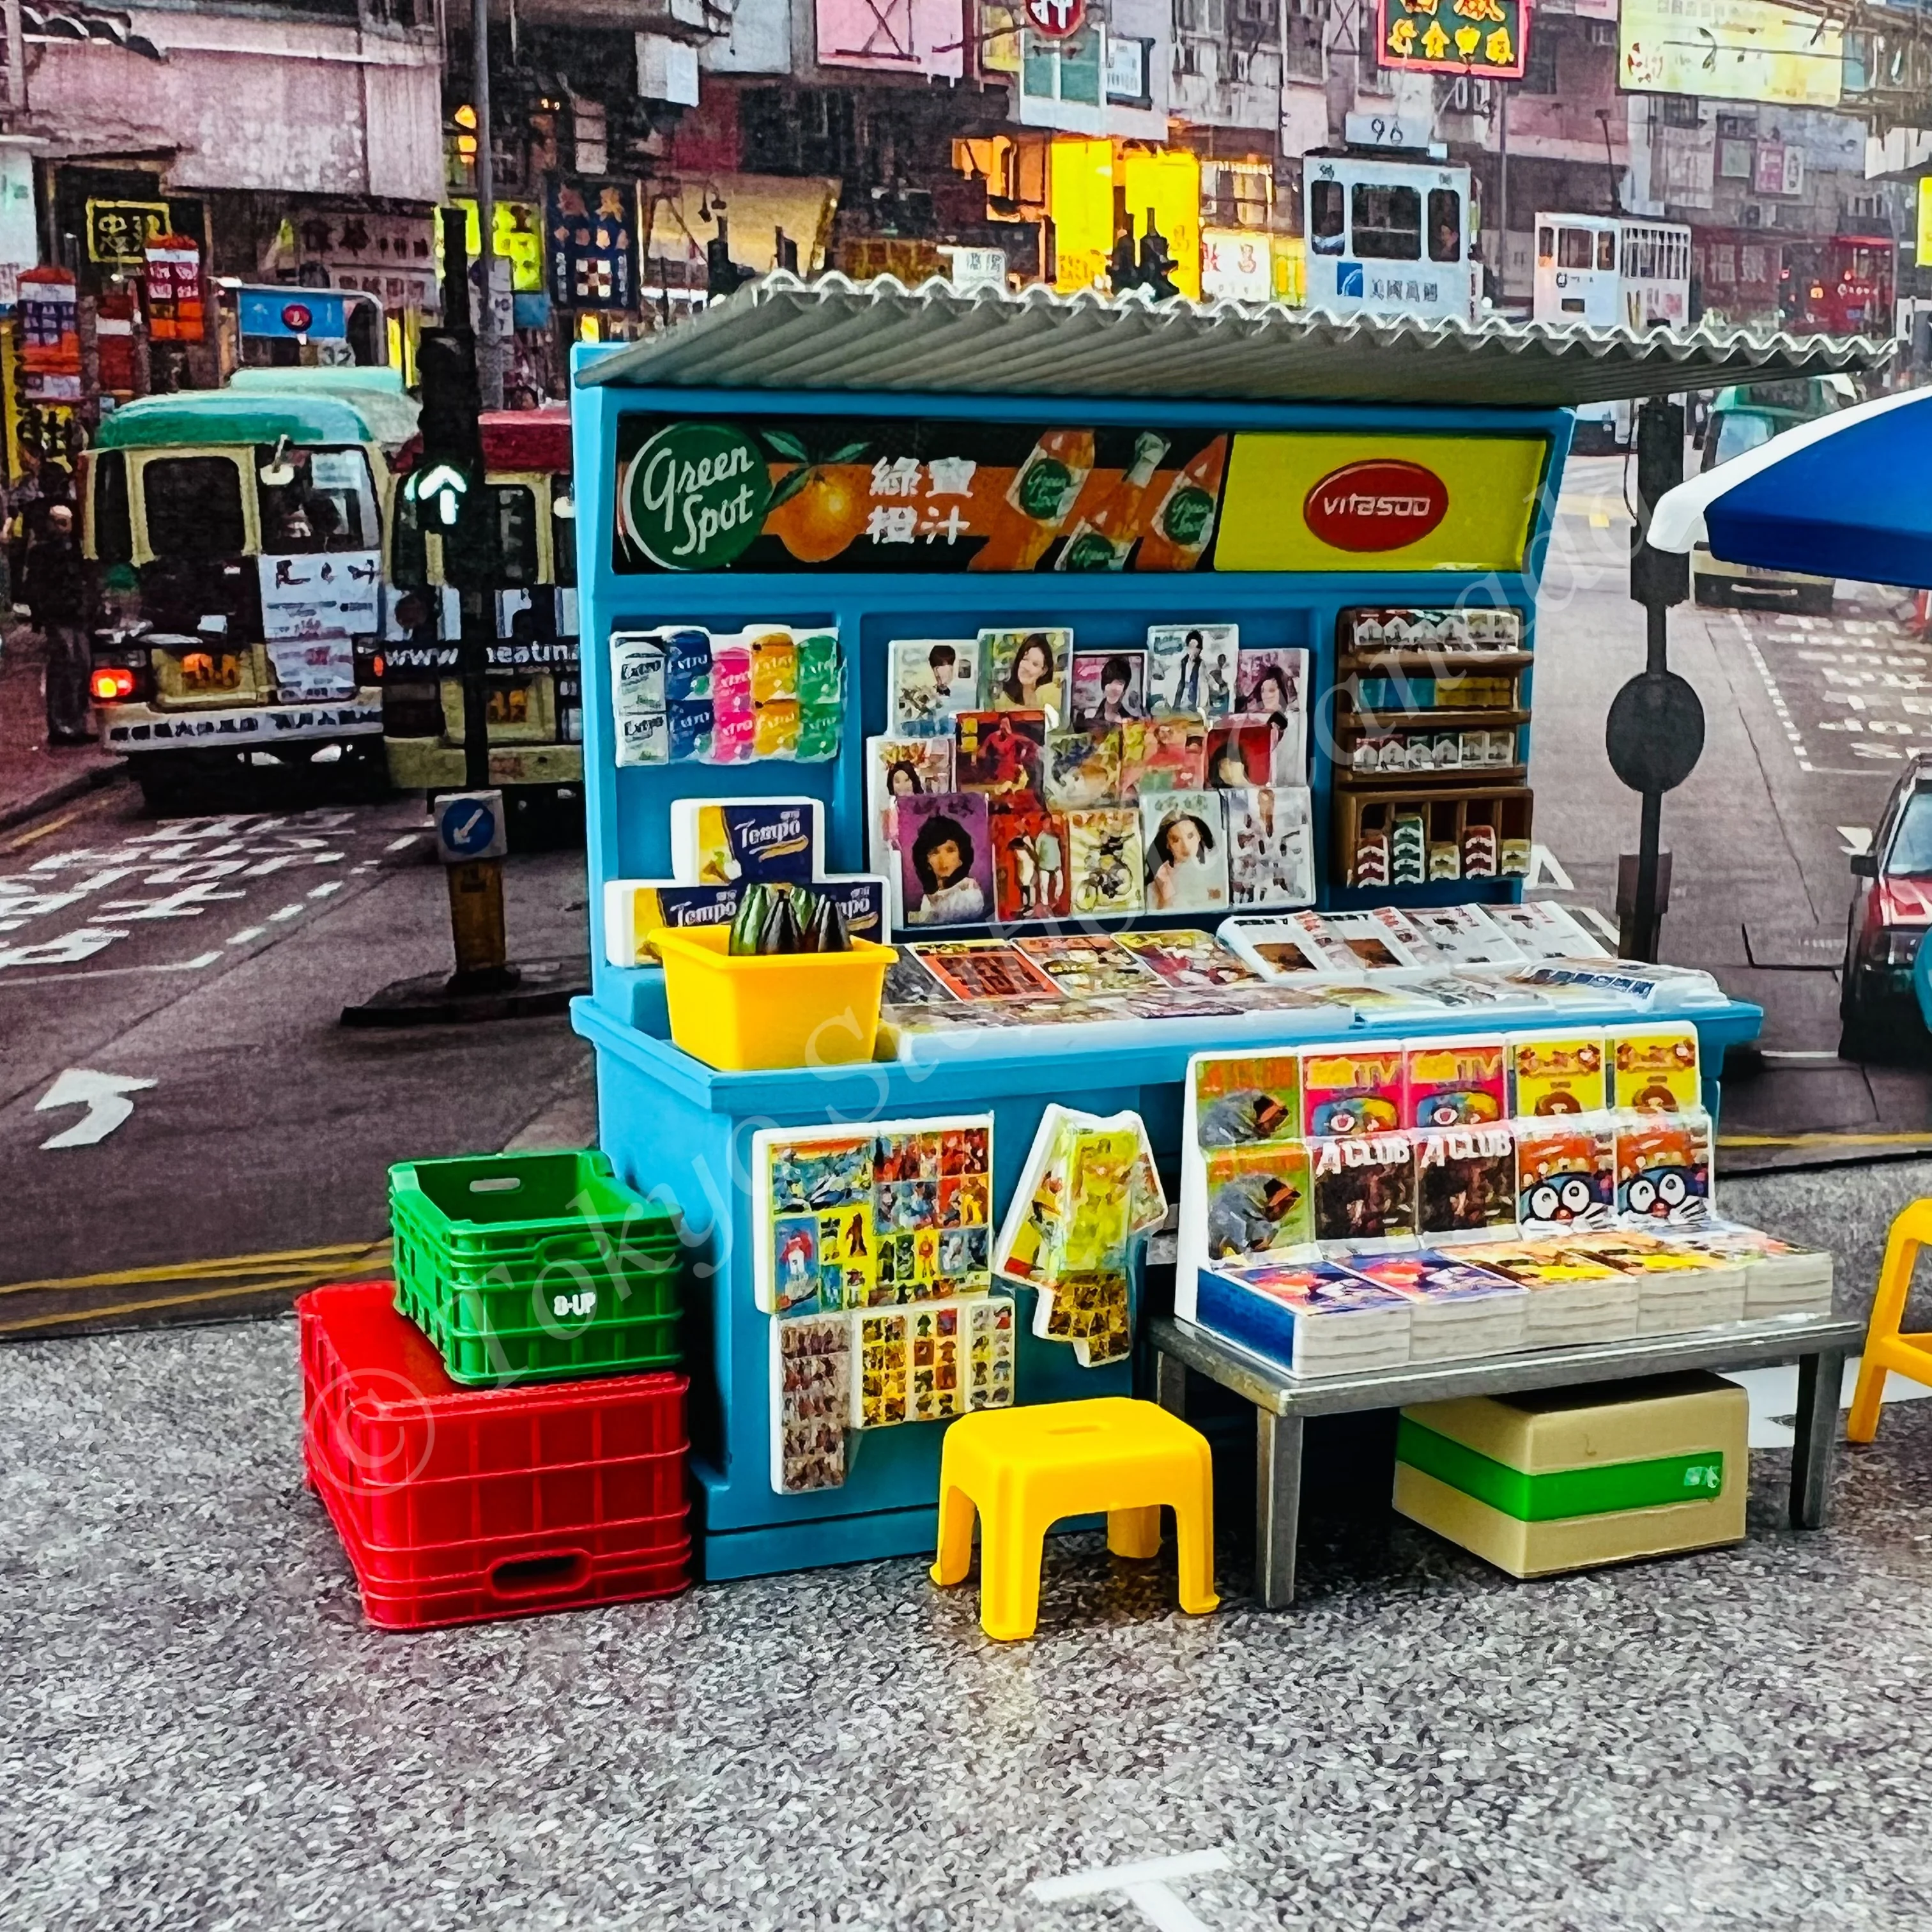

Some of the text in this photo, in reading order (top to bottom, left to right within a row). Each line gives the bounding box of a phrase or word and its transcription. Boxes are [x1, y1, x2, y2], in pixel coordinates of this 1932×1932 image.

[643, 446, 755, 533] Green
[672, 484, 754, 555] Spot
[734, 818, 801, 849] Tempo
[670, 901, 737, 928] Tempo
